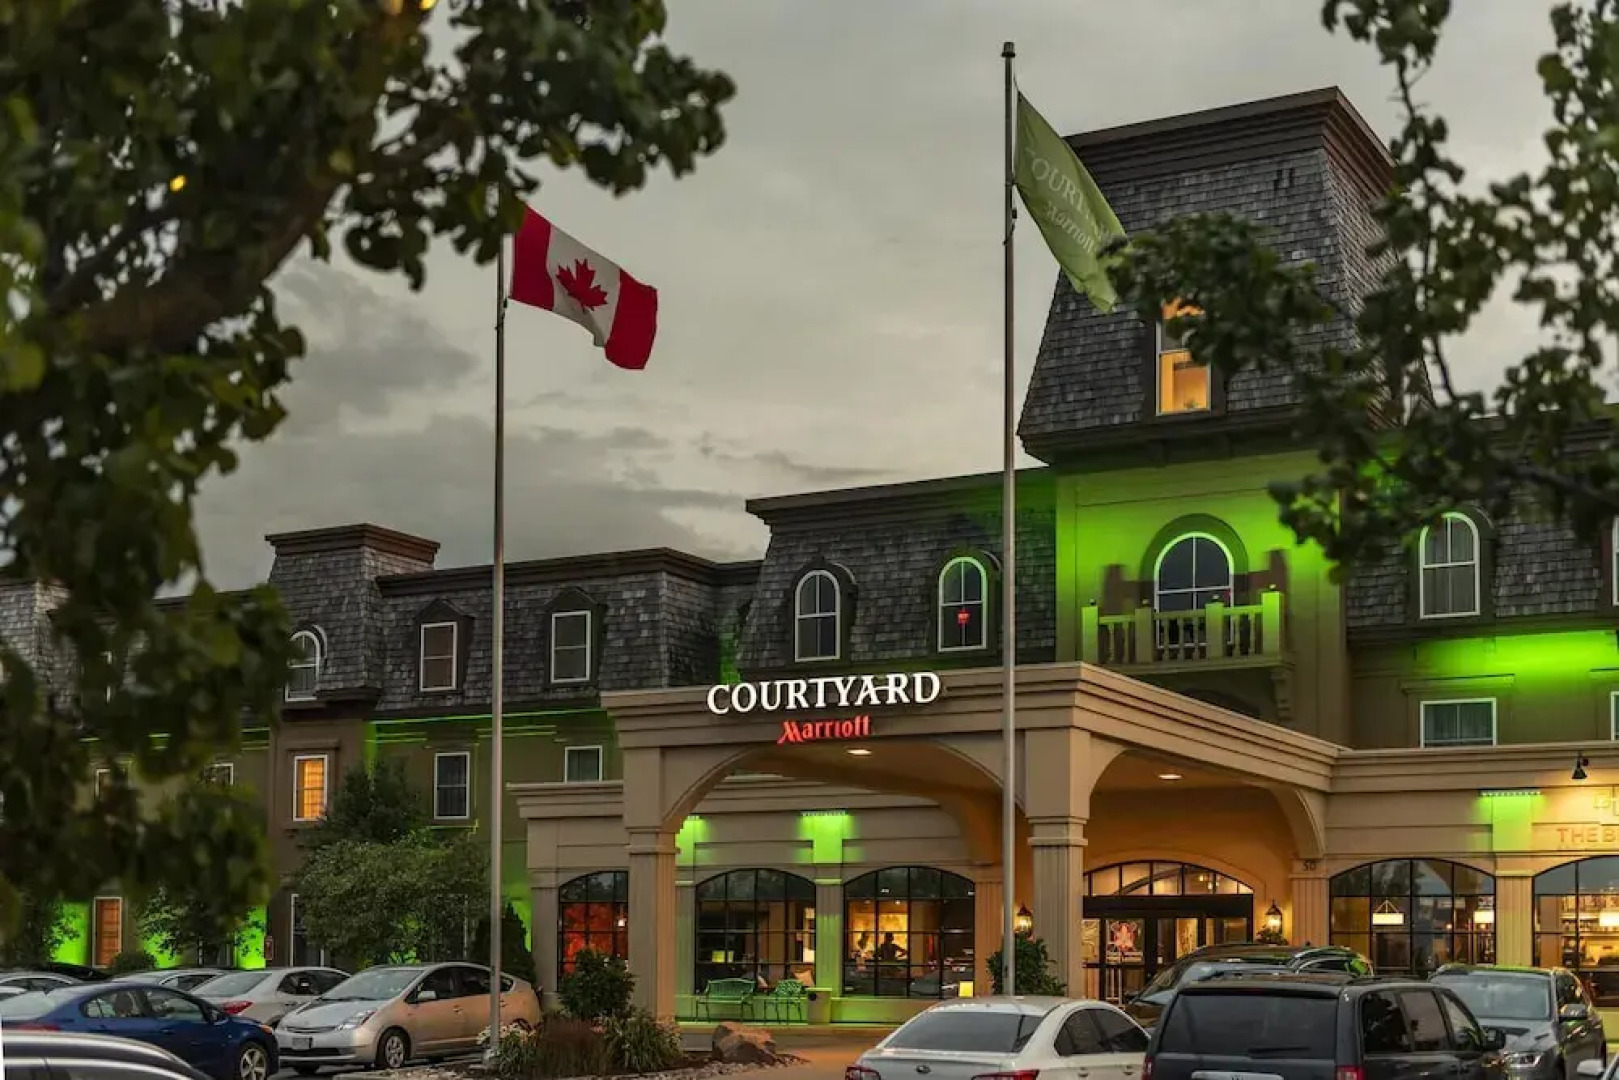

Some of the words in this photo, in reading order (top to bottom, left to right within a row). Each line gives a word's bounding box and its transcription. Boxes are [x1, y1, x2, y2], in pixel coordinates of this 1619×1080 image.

[706, 671, 941, 715] COURTYARD
[777, 714, 872, 745] Marriott
[1556, 827, 1599, 843] THE
[1602, 827, 1619, 843] B
